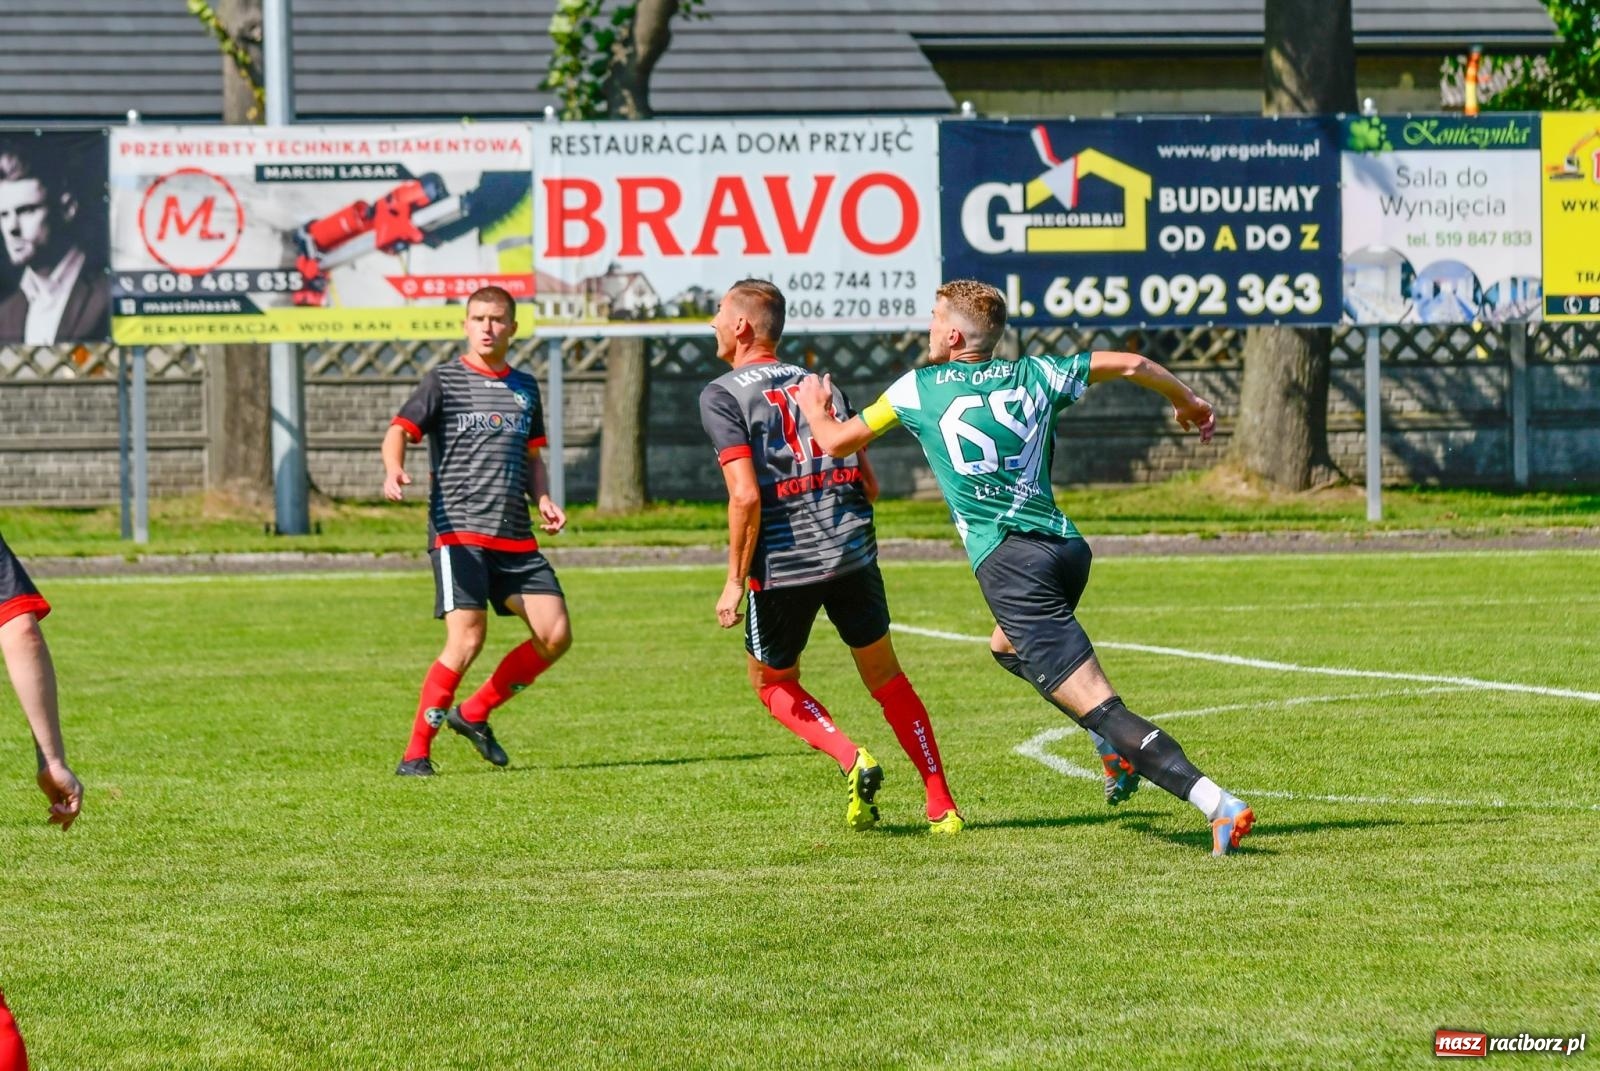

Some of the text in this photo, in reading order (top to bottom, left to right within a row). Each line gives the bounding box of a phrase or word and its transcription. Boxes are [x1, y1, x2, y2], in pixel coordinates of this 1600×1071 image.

[550, 125, 914, 157] RESTAURACJA DOM PRZYJĘĆ
[1403, 119, 1531, 150] Koniczynka
[119, 137, 522, 157] PRZEWIERTY TECHNIKĄ DIAMENTOWĄ
[1157, 139, 1320, 162] www.gregorbau.pl
[263, 164, 398, 179] MARCIN LASAK
[1396, 165, 1488, 188] Sala do
[1158, 185, 1320, 214] BUDUJEMY
[1380, 195, 1506, 221] Wynajęcia
[542, 171, 921, 258] BRAVO
[1158, 224, 1320, 252] OD A DO Z
[1407, 231, 1532, 247] tel. 519 847 833
[142, 272, 303, 292] 608 465 635
[788, 272, 825, 290] 602
[835, 272, 870, 289] 744
[881, 271, 916, 289] 173
[142, 299, 241, 313] marcinlasak
[1045, 275, 1130, 317] 665
[1140, 274, 1227, 316] 092
[1237, 273, 1323, 315] 363
[788, 299, 916, 318] 606 270 898
[143, 322, 279, 335] REKUPERACJA
[300, 321, 344, 333] WOD
[353, 320, 392, 331] KAN
[733, 369, 762, 387] LKS
[938, 385, 1038, 476] 69
